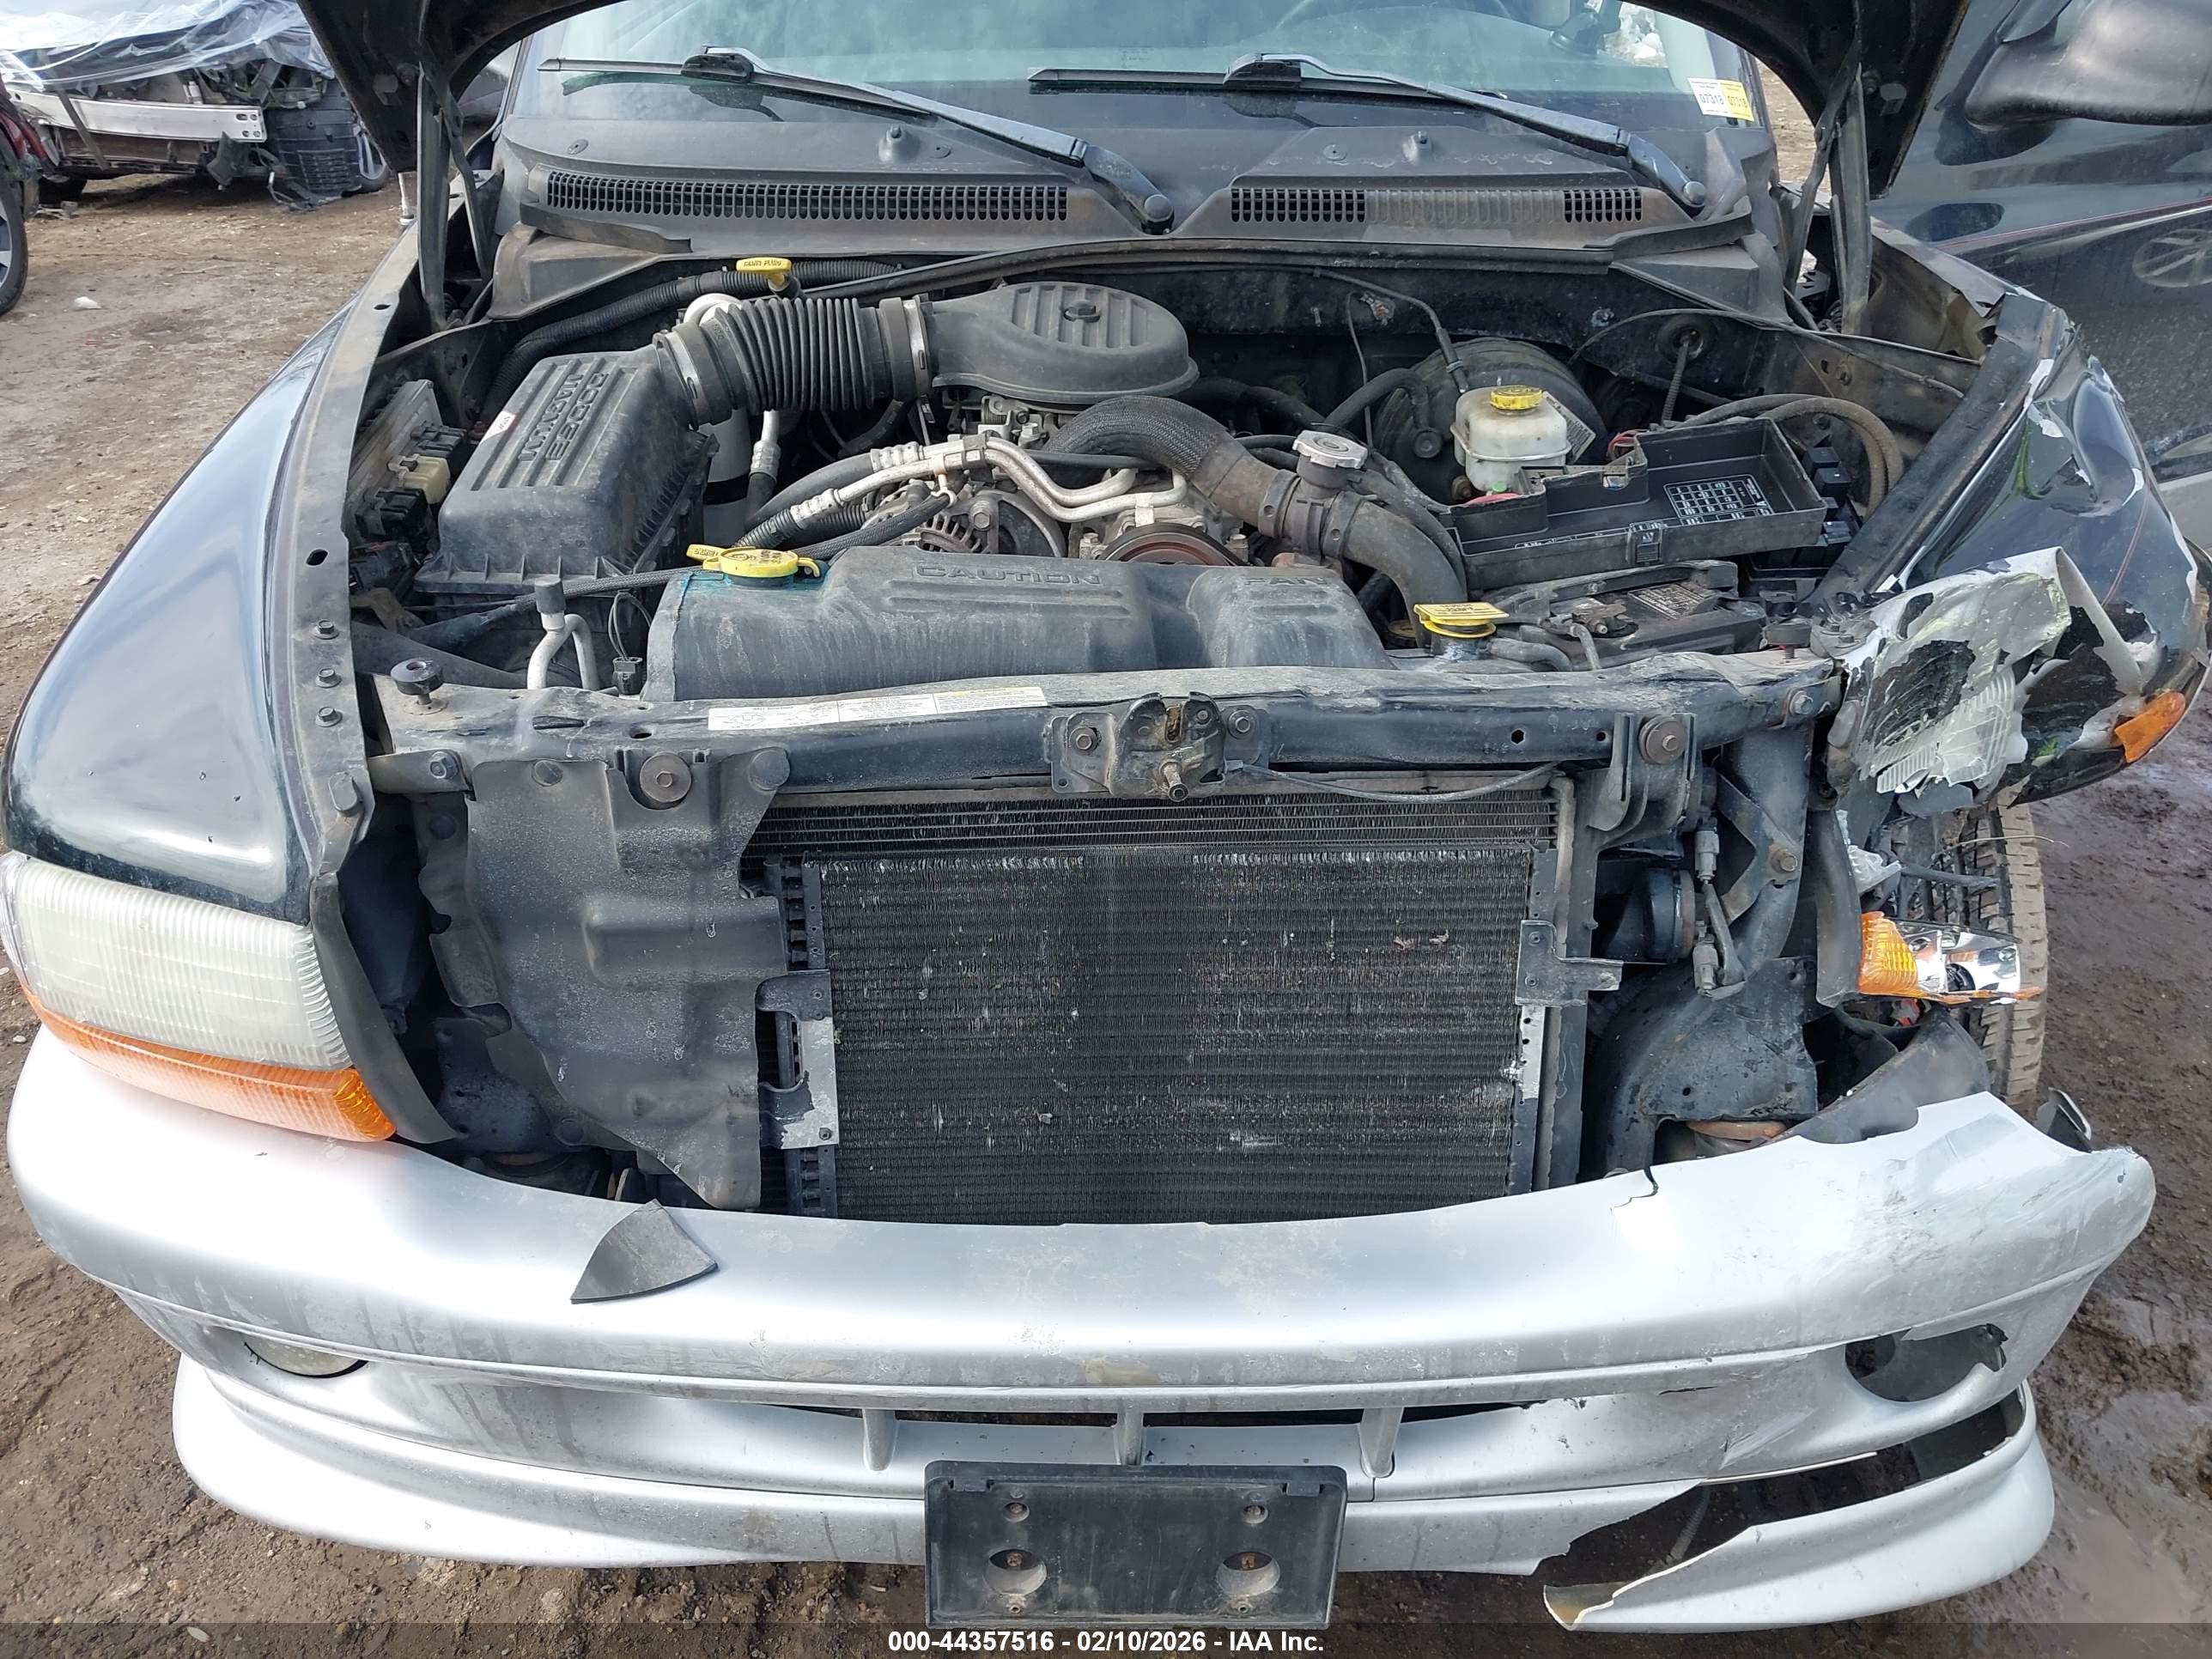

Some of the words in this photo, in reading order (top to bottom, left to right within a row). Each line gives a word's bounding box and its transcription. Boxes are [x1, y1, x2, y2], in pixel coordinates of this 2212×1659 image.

[545, 373, 609, 460] DODGE
[916, 565, 1101, 585] CAUTION
[1244, 577, 1328, 586] FAN
